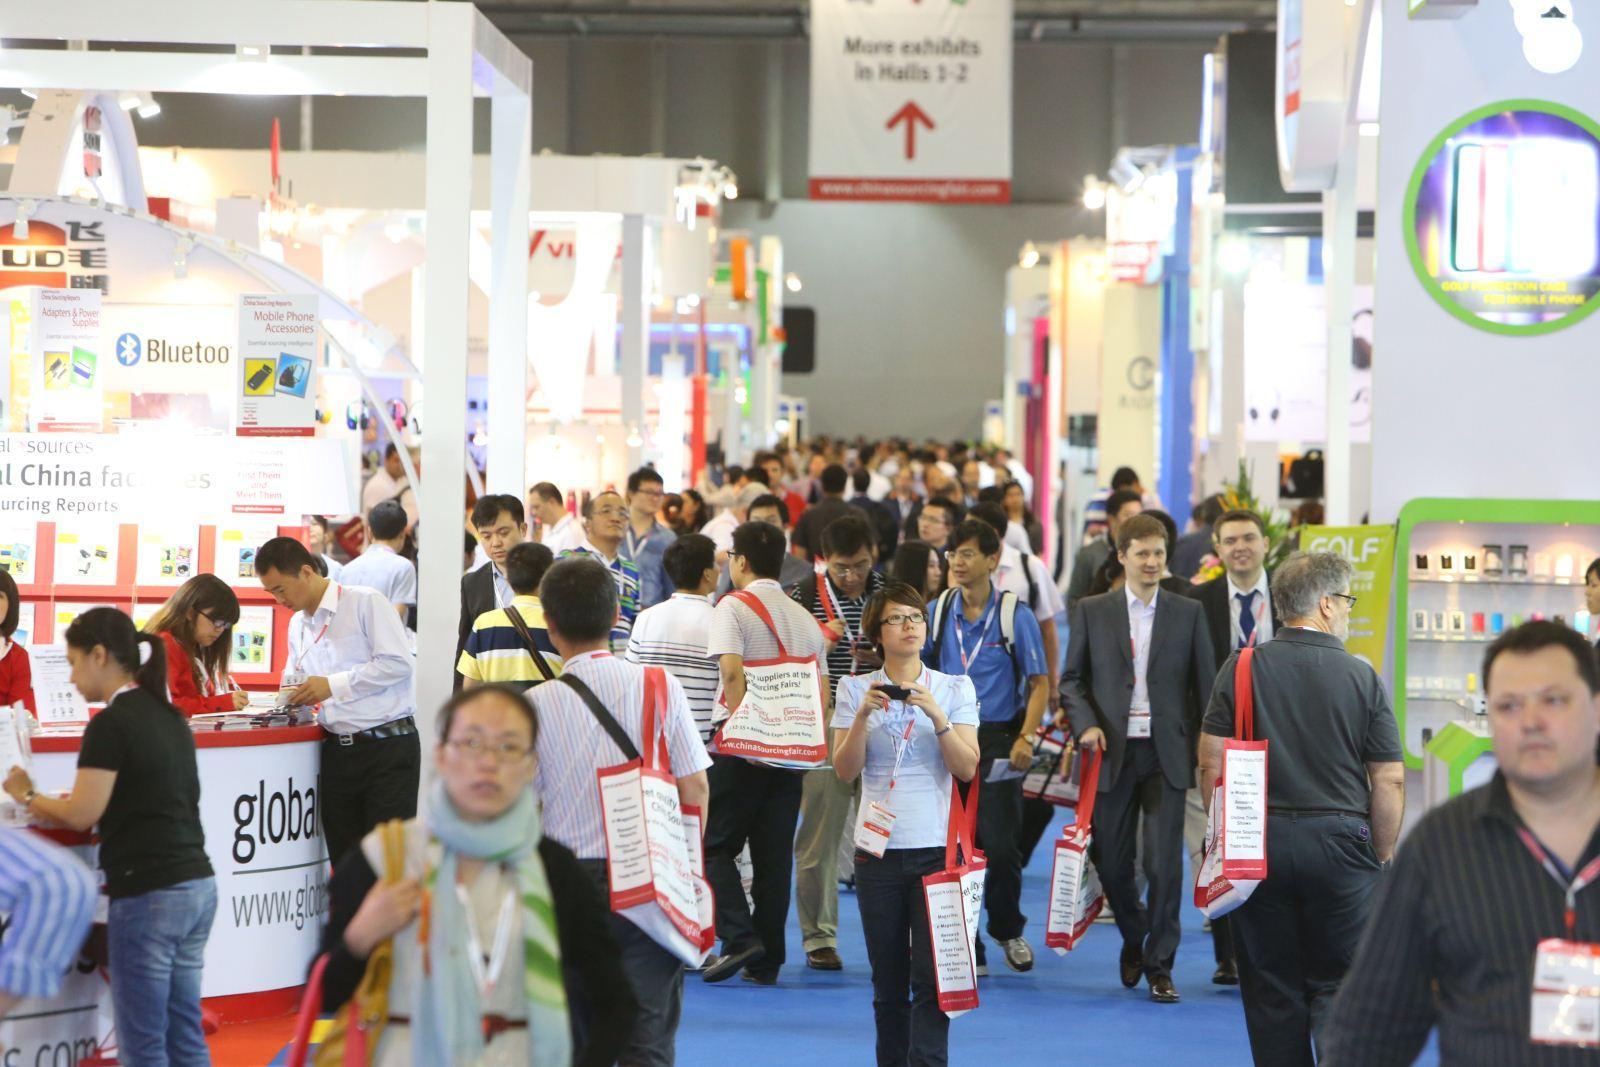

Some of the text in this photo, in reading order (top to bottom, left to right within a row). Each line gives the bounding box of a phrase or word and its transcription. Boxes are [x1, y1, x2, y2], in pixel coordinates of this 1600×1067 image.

[843, 37, 982, 56] More exhibits
[854, 62, 968, 82] in Halls 1-2
[42, 307, 71, 319] Adapters
[79, 307, 99, 318] Power
[254, 311, 315, 322] Mobile Phone
[72, 318, 99, 328] Supplies
[265, 322, 314, 333] Accessories
[147, 338, 231, 364] Bluetoo
[27, 439, 94, 455] sources
[20, 463, 92, 487] China
[56, 497, 119, 515] Reports
[1308, 535, 1382, 564] GOLF
[801, 671, 812, 679] the
[232, 773, 321, 864] global
